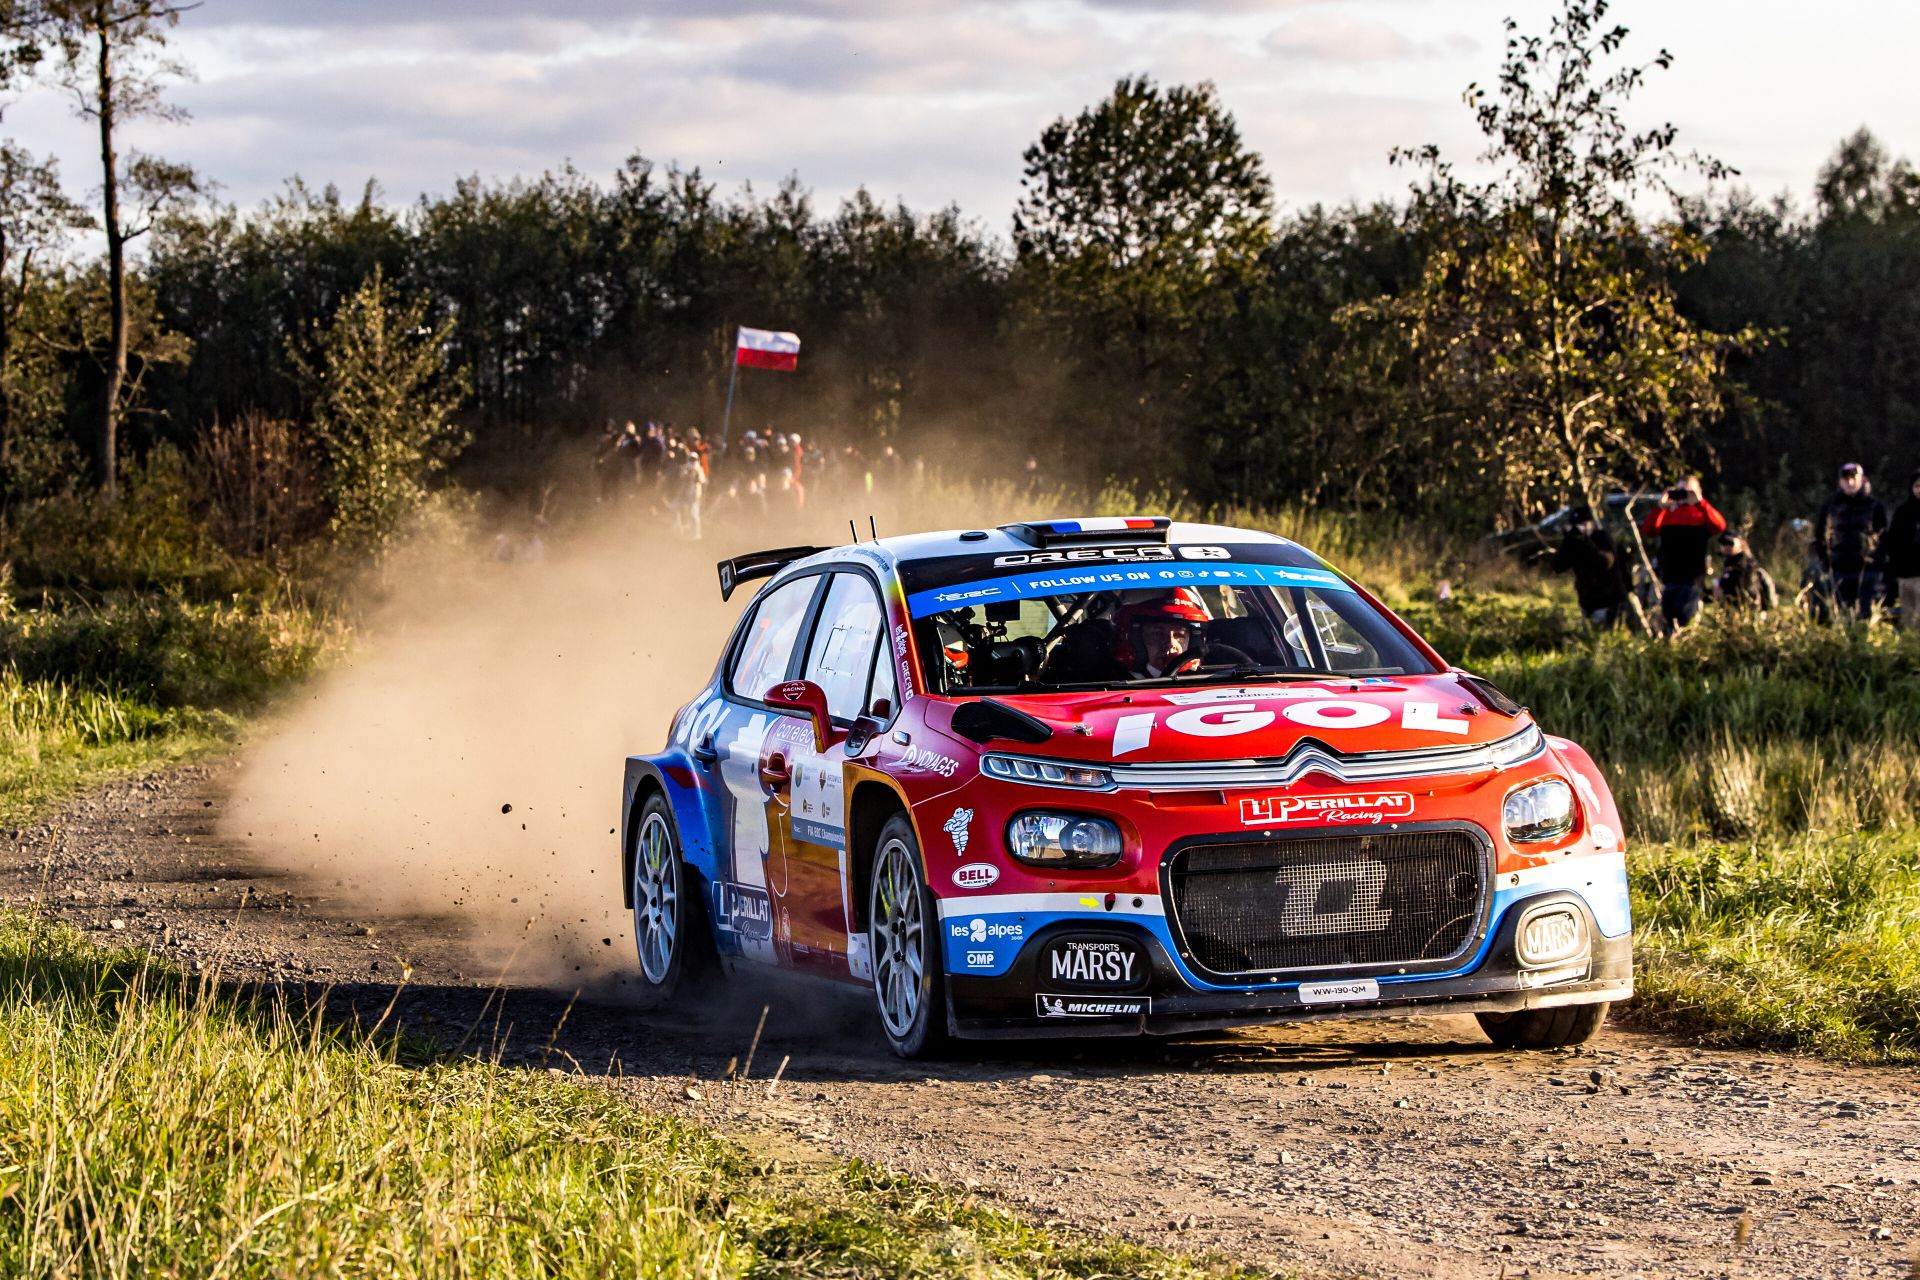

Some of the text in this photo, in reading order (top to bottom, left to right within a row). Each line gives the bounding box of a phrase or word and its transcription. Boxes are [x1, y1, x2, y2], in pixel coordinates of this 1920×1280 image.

[993, 548, 1173, 567] ORECA
[1029, 575, 1096, 590] FOLLOW
[1102, 573, 1123, 583] US
[1126, 571, 1151, 580] ON
[901, 660, 913, 691] ORECA
[1112, 700, 1470, 757] IGOL
[915, 749, 960, 778] VOYAGES
[1319, 809, 1384, 823] Racing
[958, 868, 993, 882] BELL
[951, 918, 1023, 943] les 2 alpes
[1525, 916, 1580, 954] MARSY
[1066, 942, 1120, 951] TRANSPORTS
[966, 953, 995, 966] OMP
[1051, 949, 1136, 981] MARSY
[1312, 985, 1367, 996] WW-190-QM
[1067, 1002, 1141, 1014] MICHELIN
